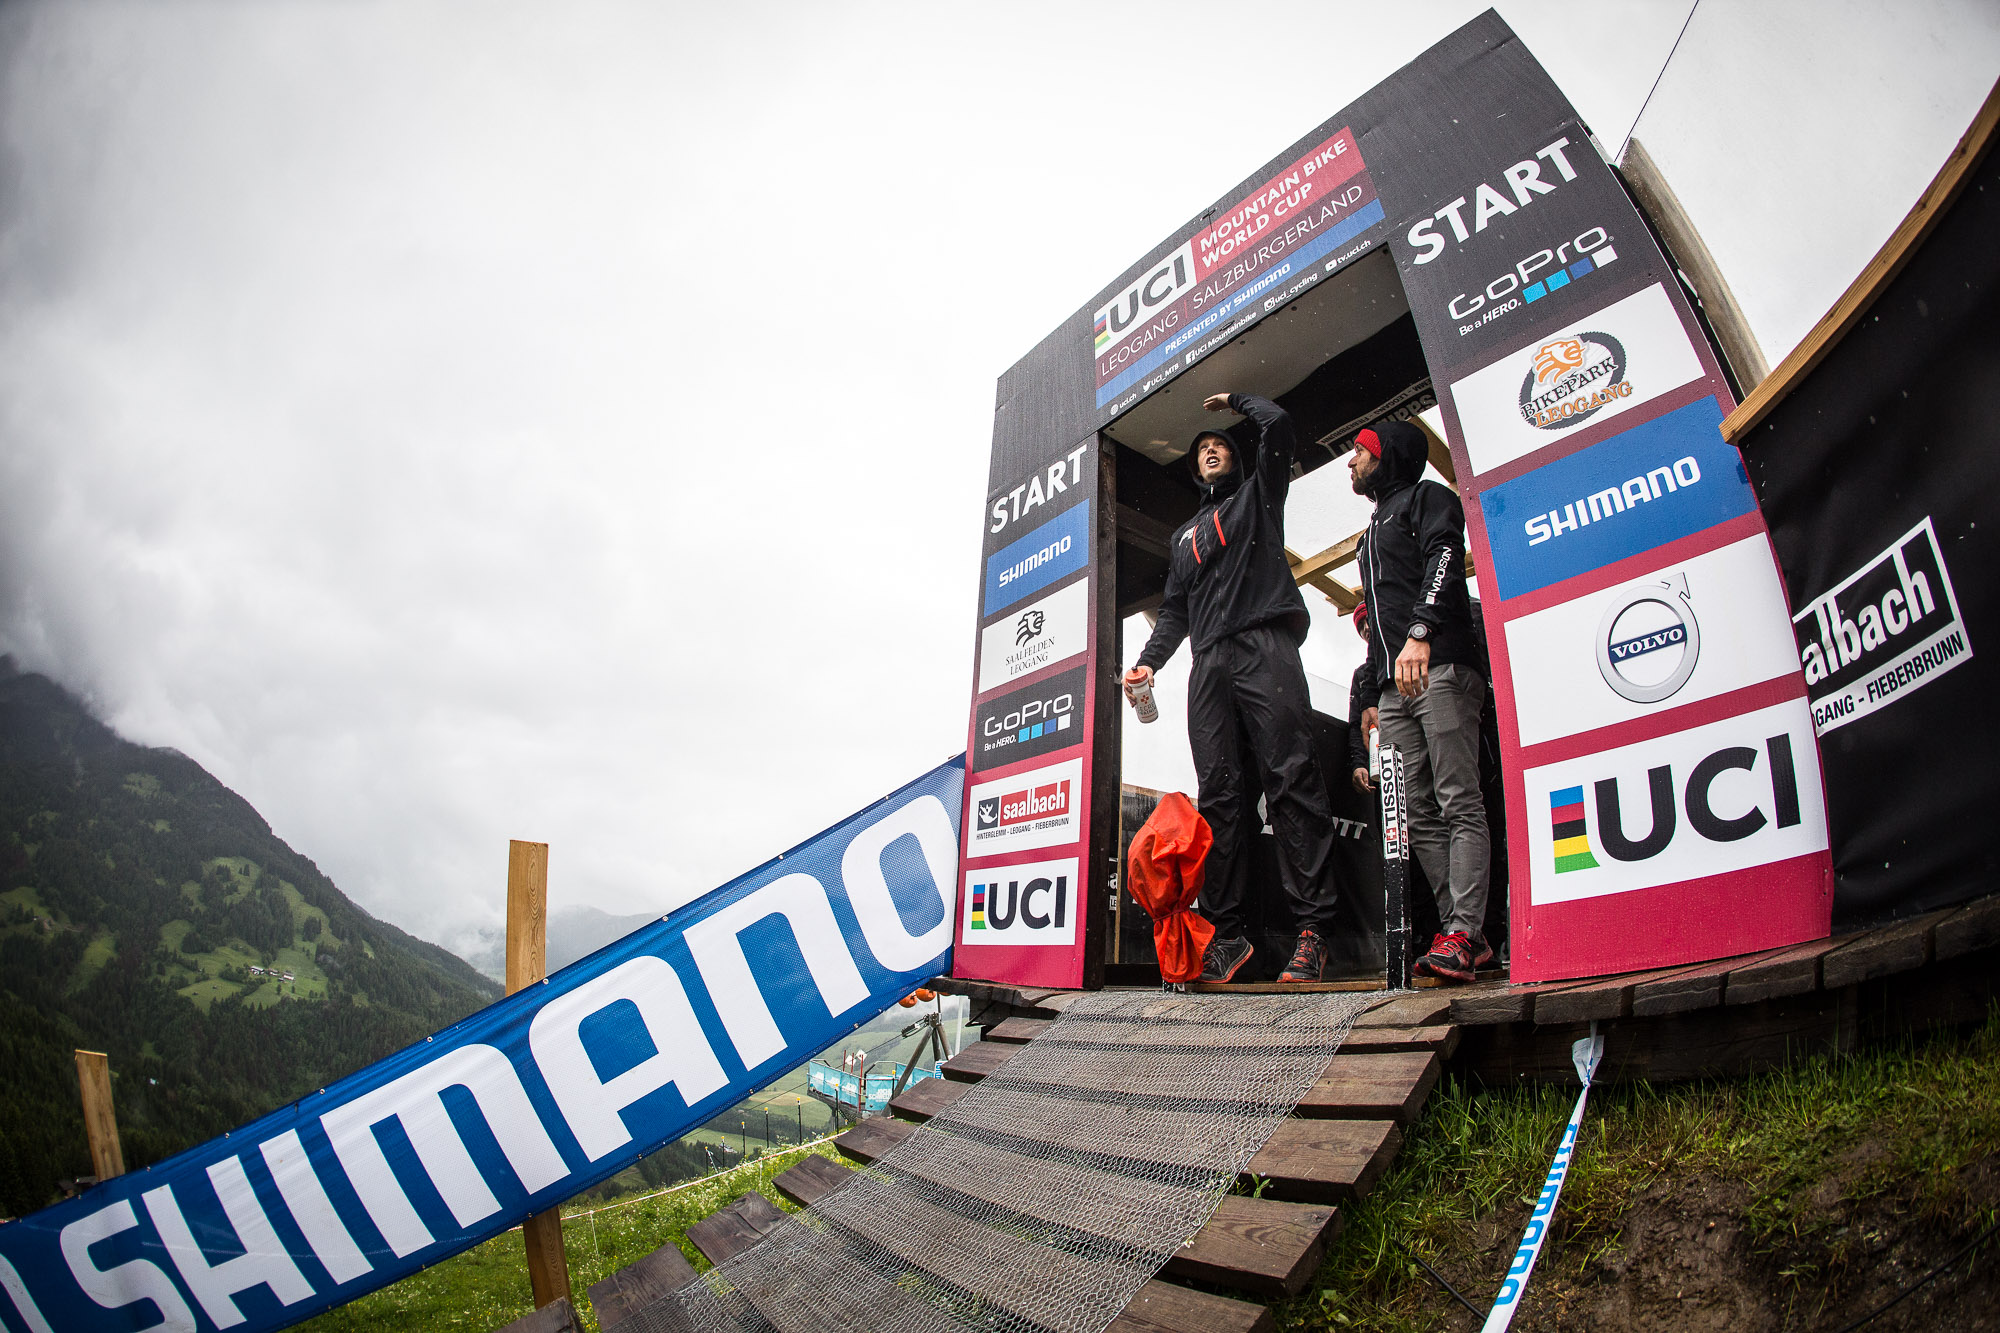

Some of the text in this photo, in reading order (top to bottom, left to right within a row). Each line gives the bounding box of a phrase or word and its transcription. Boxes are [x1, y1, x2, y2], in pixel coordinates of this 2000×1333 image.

[1199, 138, 1348, 252] MOUNTAIN BIKE
[1407, 137, 1578, 265] START
[1201, 182, 1313, 268] WORLD CUP
[1337, 240, 1371, 264] tv.uci.ch
[1101, 185, 1363, 377] LEOGANG SALZBURGERLAND
[1109, 257, 1187, 334] UCI
[1275, 272, 1318, 303] uci_cycling
[1448, 226, 1608, 320] GoPro
[1164, 263, 1291, 355] PRESENTED BY SHIMANO
[1194, 311, 1257, 357] UCI Mountainbike
[1458, 323, 1473, 336] Be
[1521, 356, 1618, 419] BIKEPARK
[1534, 380, 1633, 428] LEOGANG
[990, 444, 1088, 534] START
[1525, 456, 1701, 546] SHIMANO
[999, 535, 1071, 588] SHIMANO
[1426, 546, 1452, 597] MADISON
[1005, 636, 1056, 666] SAALFELDEN
[1010, 651, 1049, 676] LEOGANG
[1611, 627, 1684, 659] VOLVO
[1812, 694, 1855, 728] GANG
[1866, 630, 1965, 704] FIEBERBRUNN
[984, 693, 1073, 737] GoPro
[984, 742, 992, 752] Be
[1003, 782, 1066, 820] saalbach
[1381, 755, 1396, 827] TISSOT
[1396, 752, 1406, 828] TISSOT
[1594, 733, 1801, 862] UCI
[976, 827, 1006, 841] HINTERGLEMM
[1010, 824, 1031, 836] LEOGANG
[1035, 817, 1070, 831] FIEBERBRUNN
[987, 876, 1067, 930] UCI
[60, 794, 959, 1333] SHIMANO
